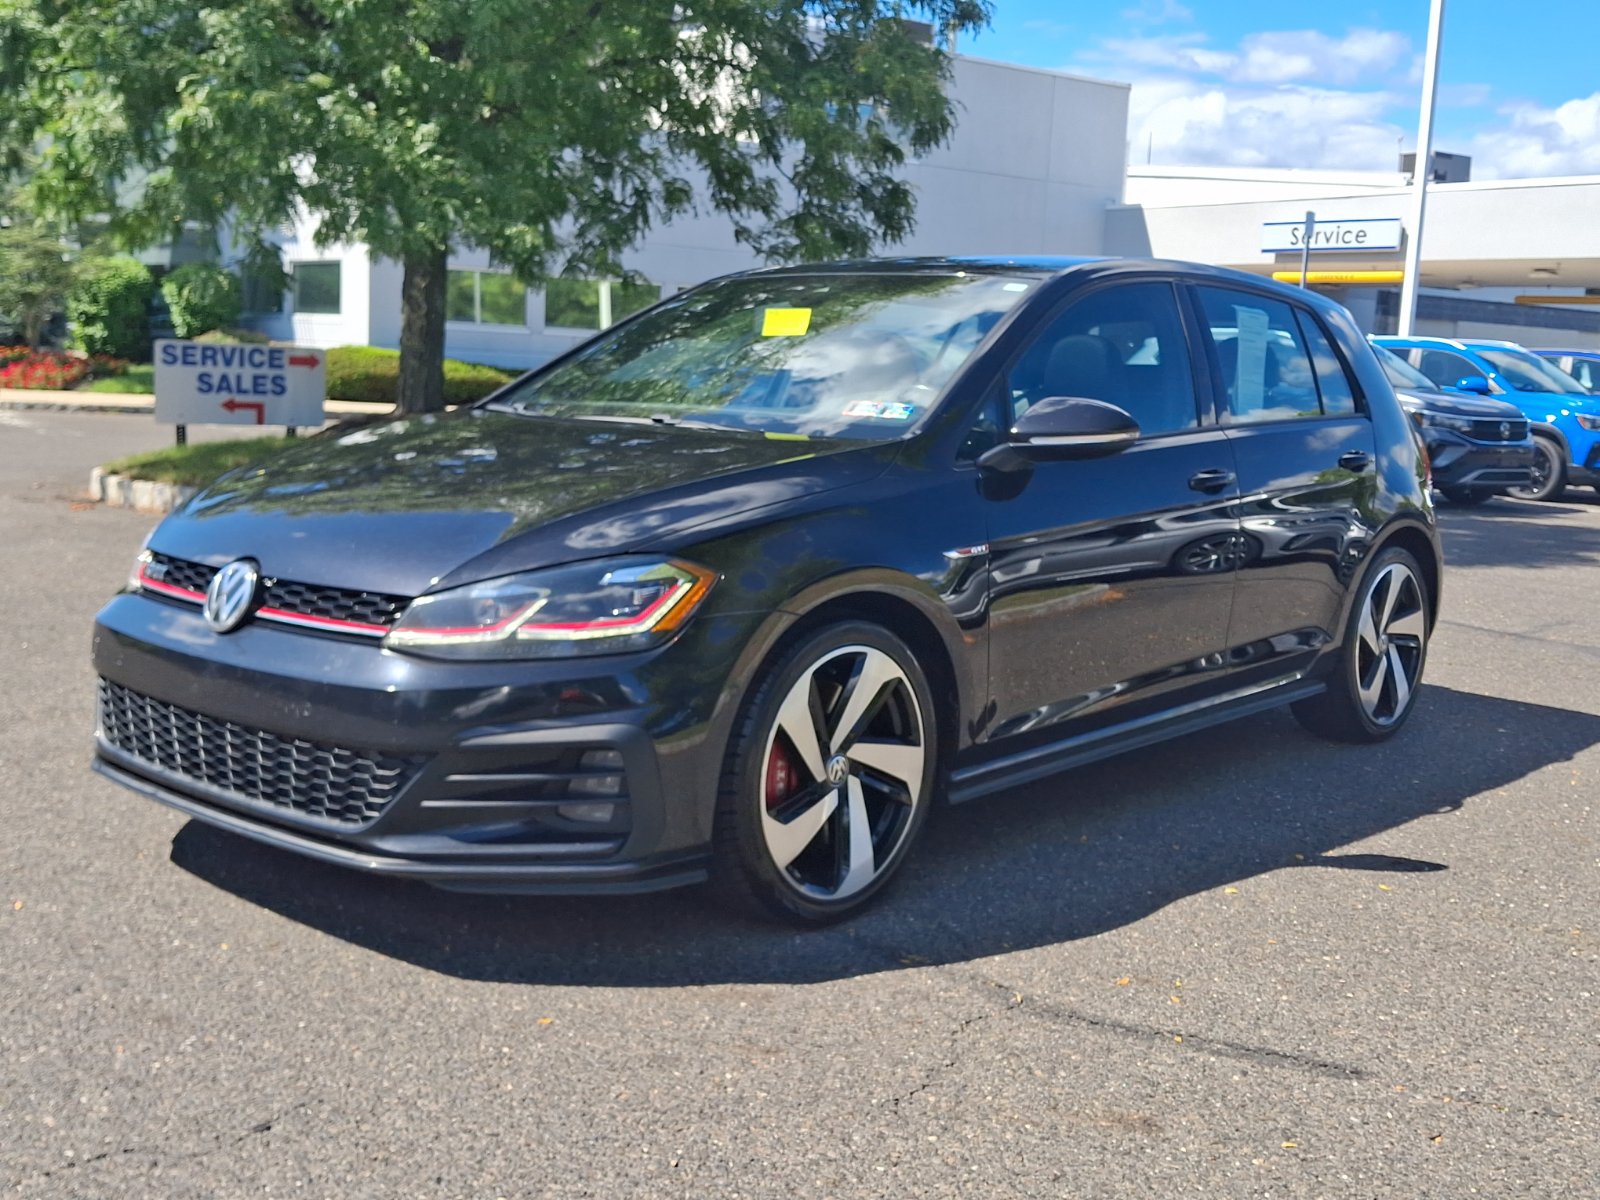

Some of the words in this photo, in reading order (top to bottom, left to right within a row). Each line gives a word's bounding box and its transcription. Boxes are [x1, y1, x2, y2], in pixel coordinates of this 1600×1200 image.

[162, 344, 285, 369] SERVICE
[197, 373, 287, 396] SALES
[205, 561, 257, 632] VW
